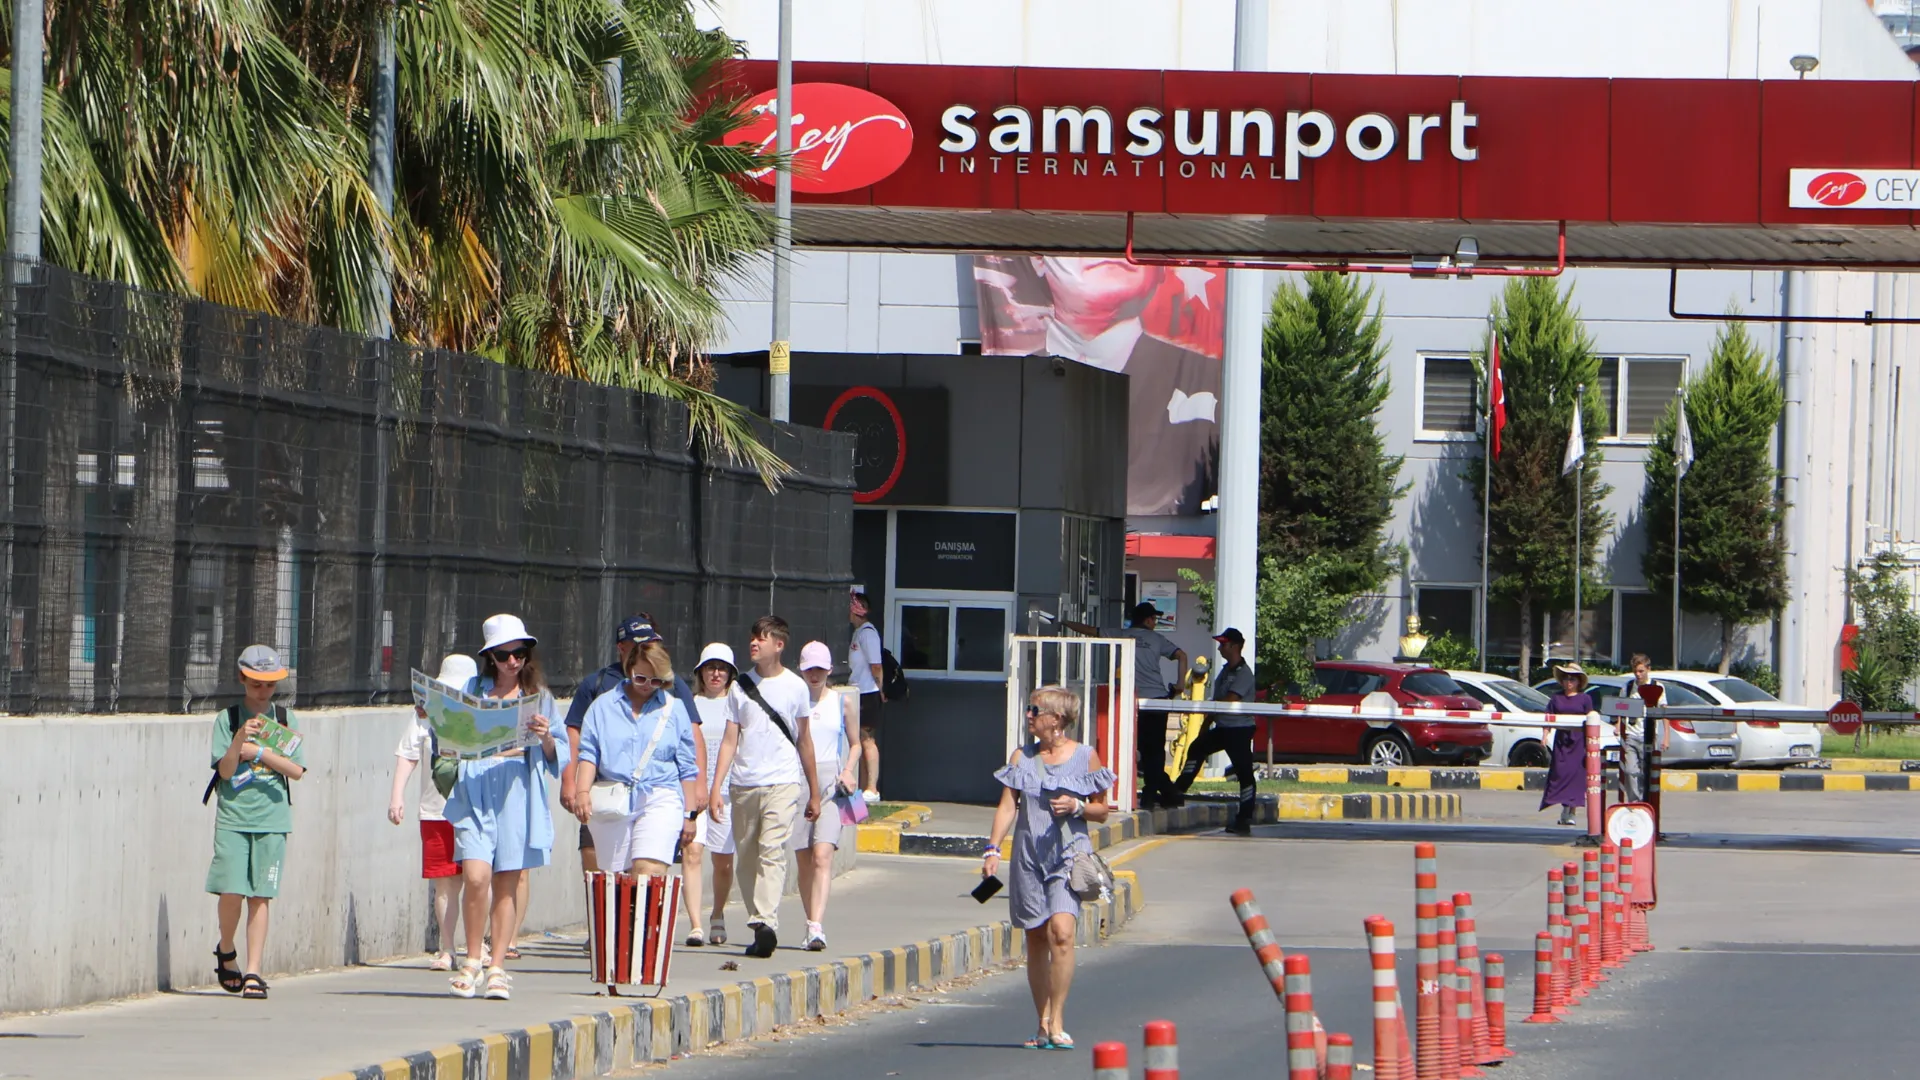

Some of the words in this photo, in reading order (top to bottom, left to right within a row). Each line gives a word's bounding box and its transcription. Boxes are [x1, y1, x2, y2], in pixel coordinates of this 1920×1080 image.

[939, 100, 1479, 181] samsunport
[938, 155, 1282, 180] INTERNATIONAL
[1813, 180, 1865, 203] Cey
[1875, 178, 1919, 202] CEY
[934, 541, 976, 553] DANIŞMA
[1831, 713, 1860, 723] DUR
